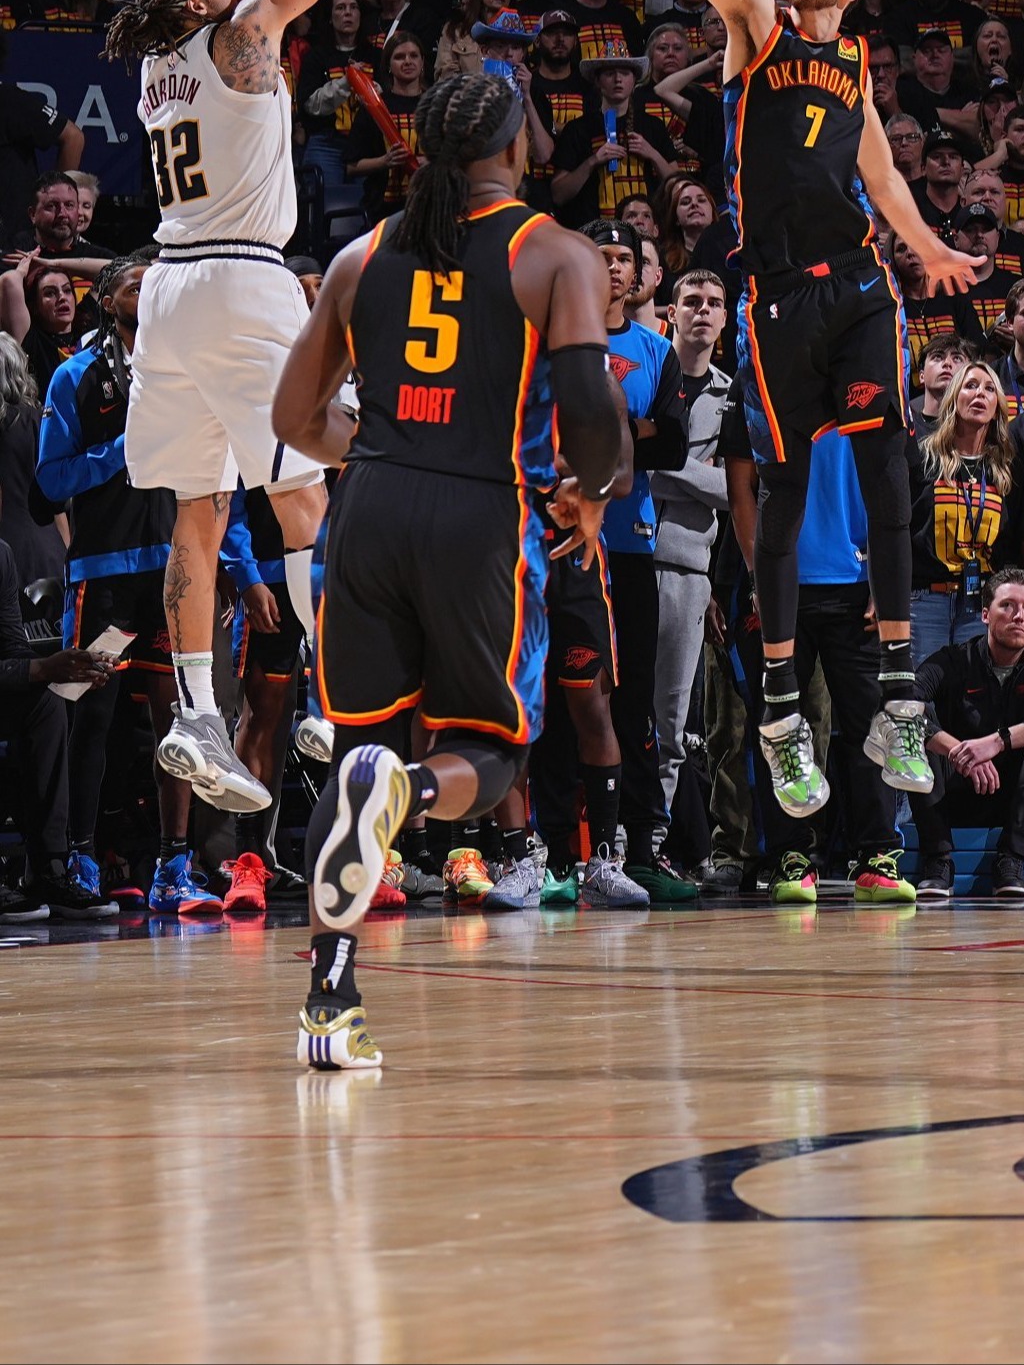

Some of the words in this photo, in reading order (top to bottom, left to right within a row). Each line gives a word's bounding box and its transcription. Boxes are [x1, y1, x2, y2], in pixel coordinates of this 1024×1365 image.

[142, 81, 201, 118] GORDON
[765, 59, 859, 112] OKLAHOMA
[803, 103, 827, 148] 7
[150, 120, 209, 207] 32
[404, 268, 465, 374] 5
[396, 384, 456, 424] DORT
